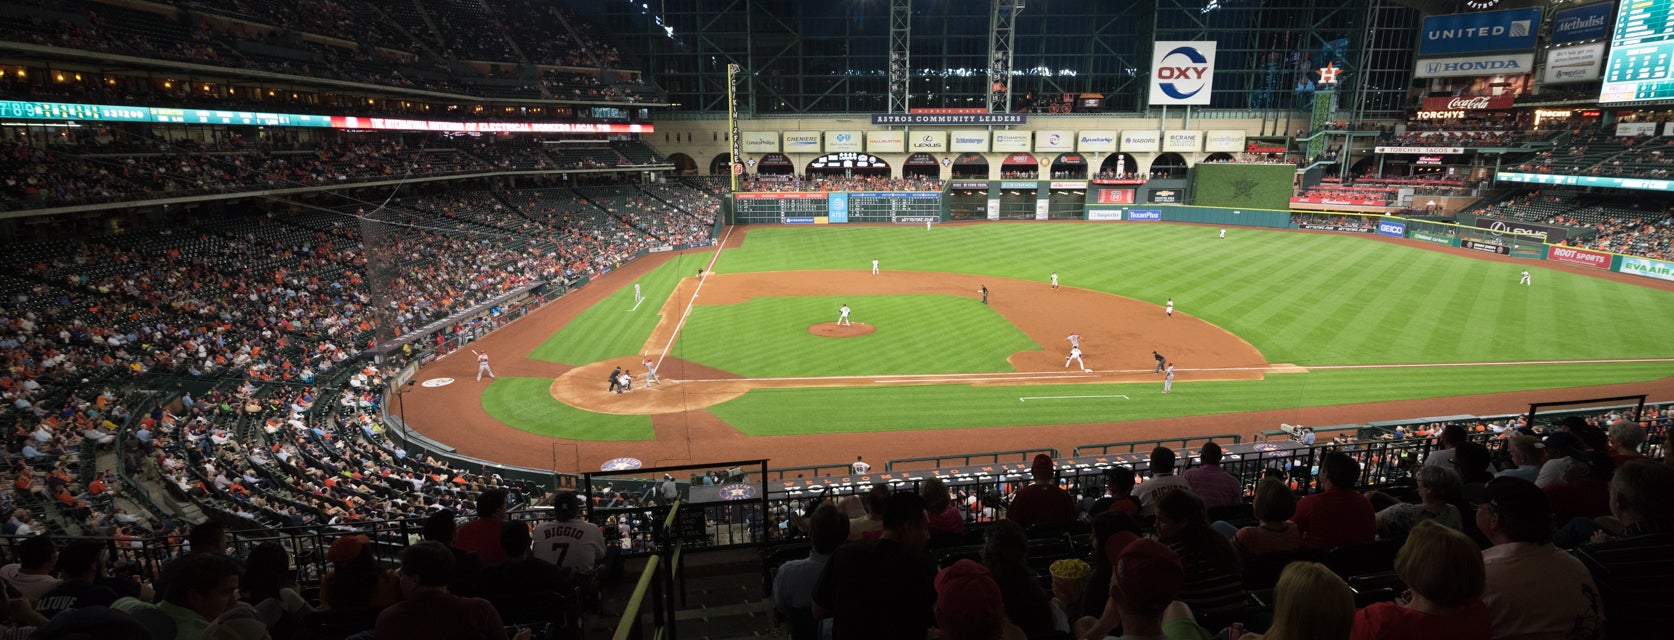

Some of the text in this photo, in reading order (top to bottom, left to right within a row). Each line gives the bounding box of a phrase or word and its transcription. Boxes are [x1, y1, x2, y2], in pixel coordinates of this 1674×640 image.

[1556, 15, 1605, 32] Methodist
[1428, 25, 1505, 41] UNITED
[1443, 59, 1520, 72] HONDA
[1158, 66, 1208, 80] OXY
[1, 103, 7, 116] 7
[12, 104, 21, 117] 8
[25, 104, 34, 118] 9
[1417, 110, 1465, 120] TORCHYS
[877, 114, 1022, 123] ASTROS COMMUNITY LEADERS
[466, 122, 478, 131] OF
[480, 122, 530, 132] ELECTRICAL
[532, 123, 571, 132] WORKERS
[572, 123, 596, 132] LOCAL
[1321, 197, 1351, 205] Budweiser
[1130, 210, 1159, 219] TexanPlus
[1380, 223, 1403, 235] GEICO
[1554, 247, 1577, 258] ROOT
[1576, 253, 1605, 263] SPORTS
[1625, 262, 1670, 275] EVA AIR
[784, 472, 911, 487] WELCOME
[544, 526, 584, 540] BIGGIO
[551, 542, 570, 567] 7
